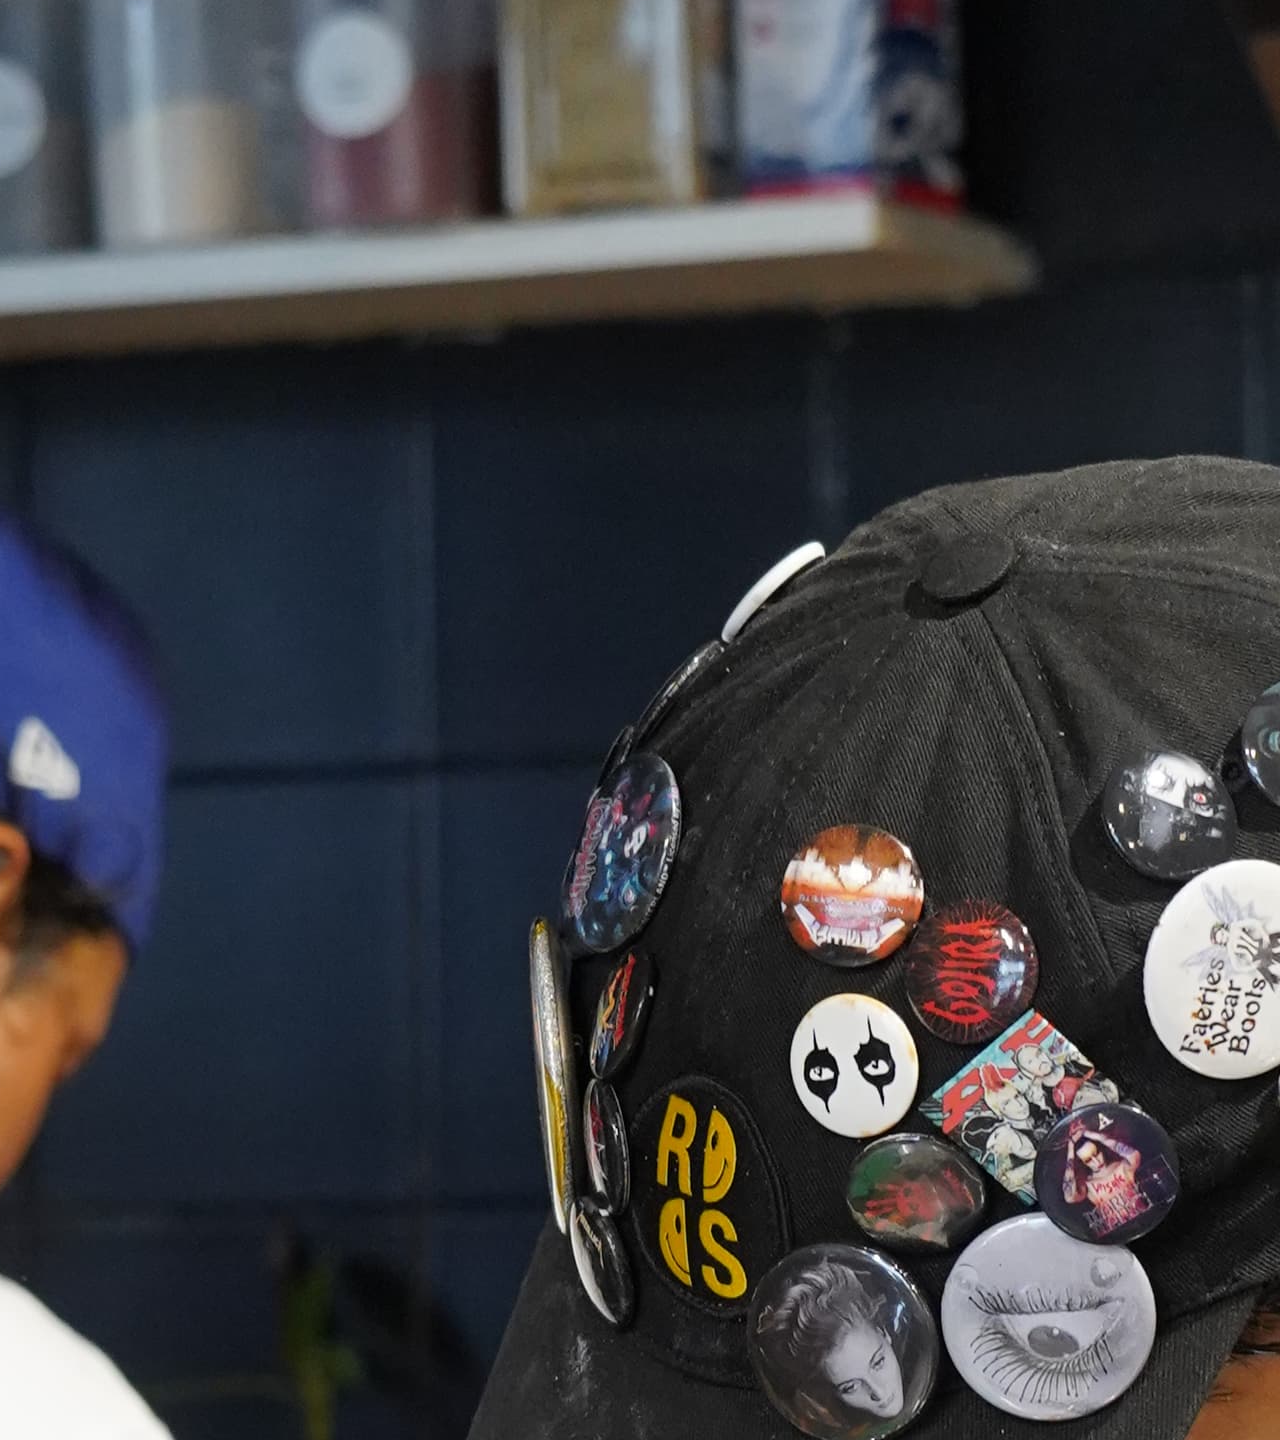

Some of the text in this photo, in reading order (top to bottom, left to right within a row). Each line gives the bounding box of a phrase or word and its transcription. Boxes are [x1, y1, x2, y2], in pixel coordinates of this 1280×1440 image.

[926, 920, 1003, 1024] GOJIRA
[1178, 956, 1227, 1057] Faeries
[1210, 978, 1241, 1057] Wear
[1229, 974, 1267, 1056] Boots
